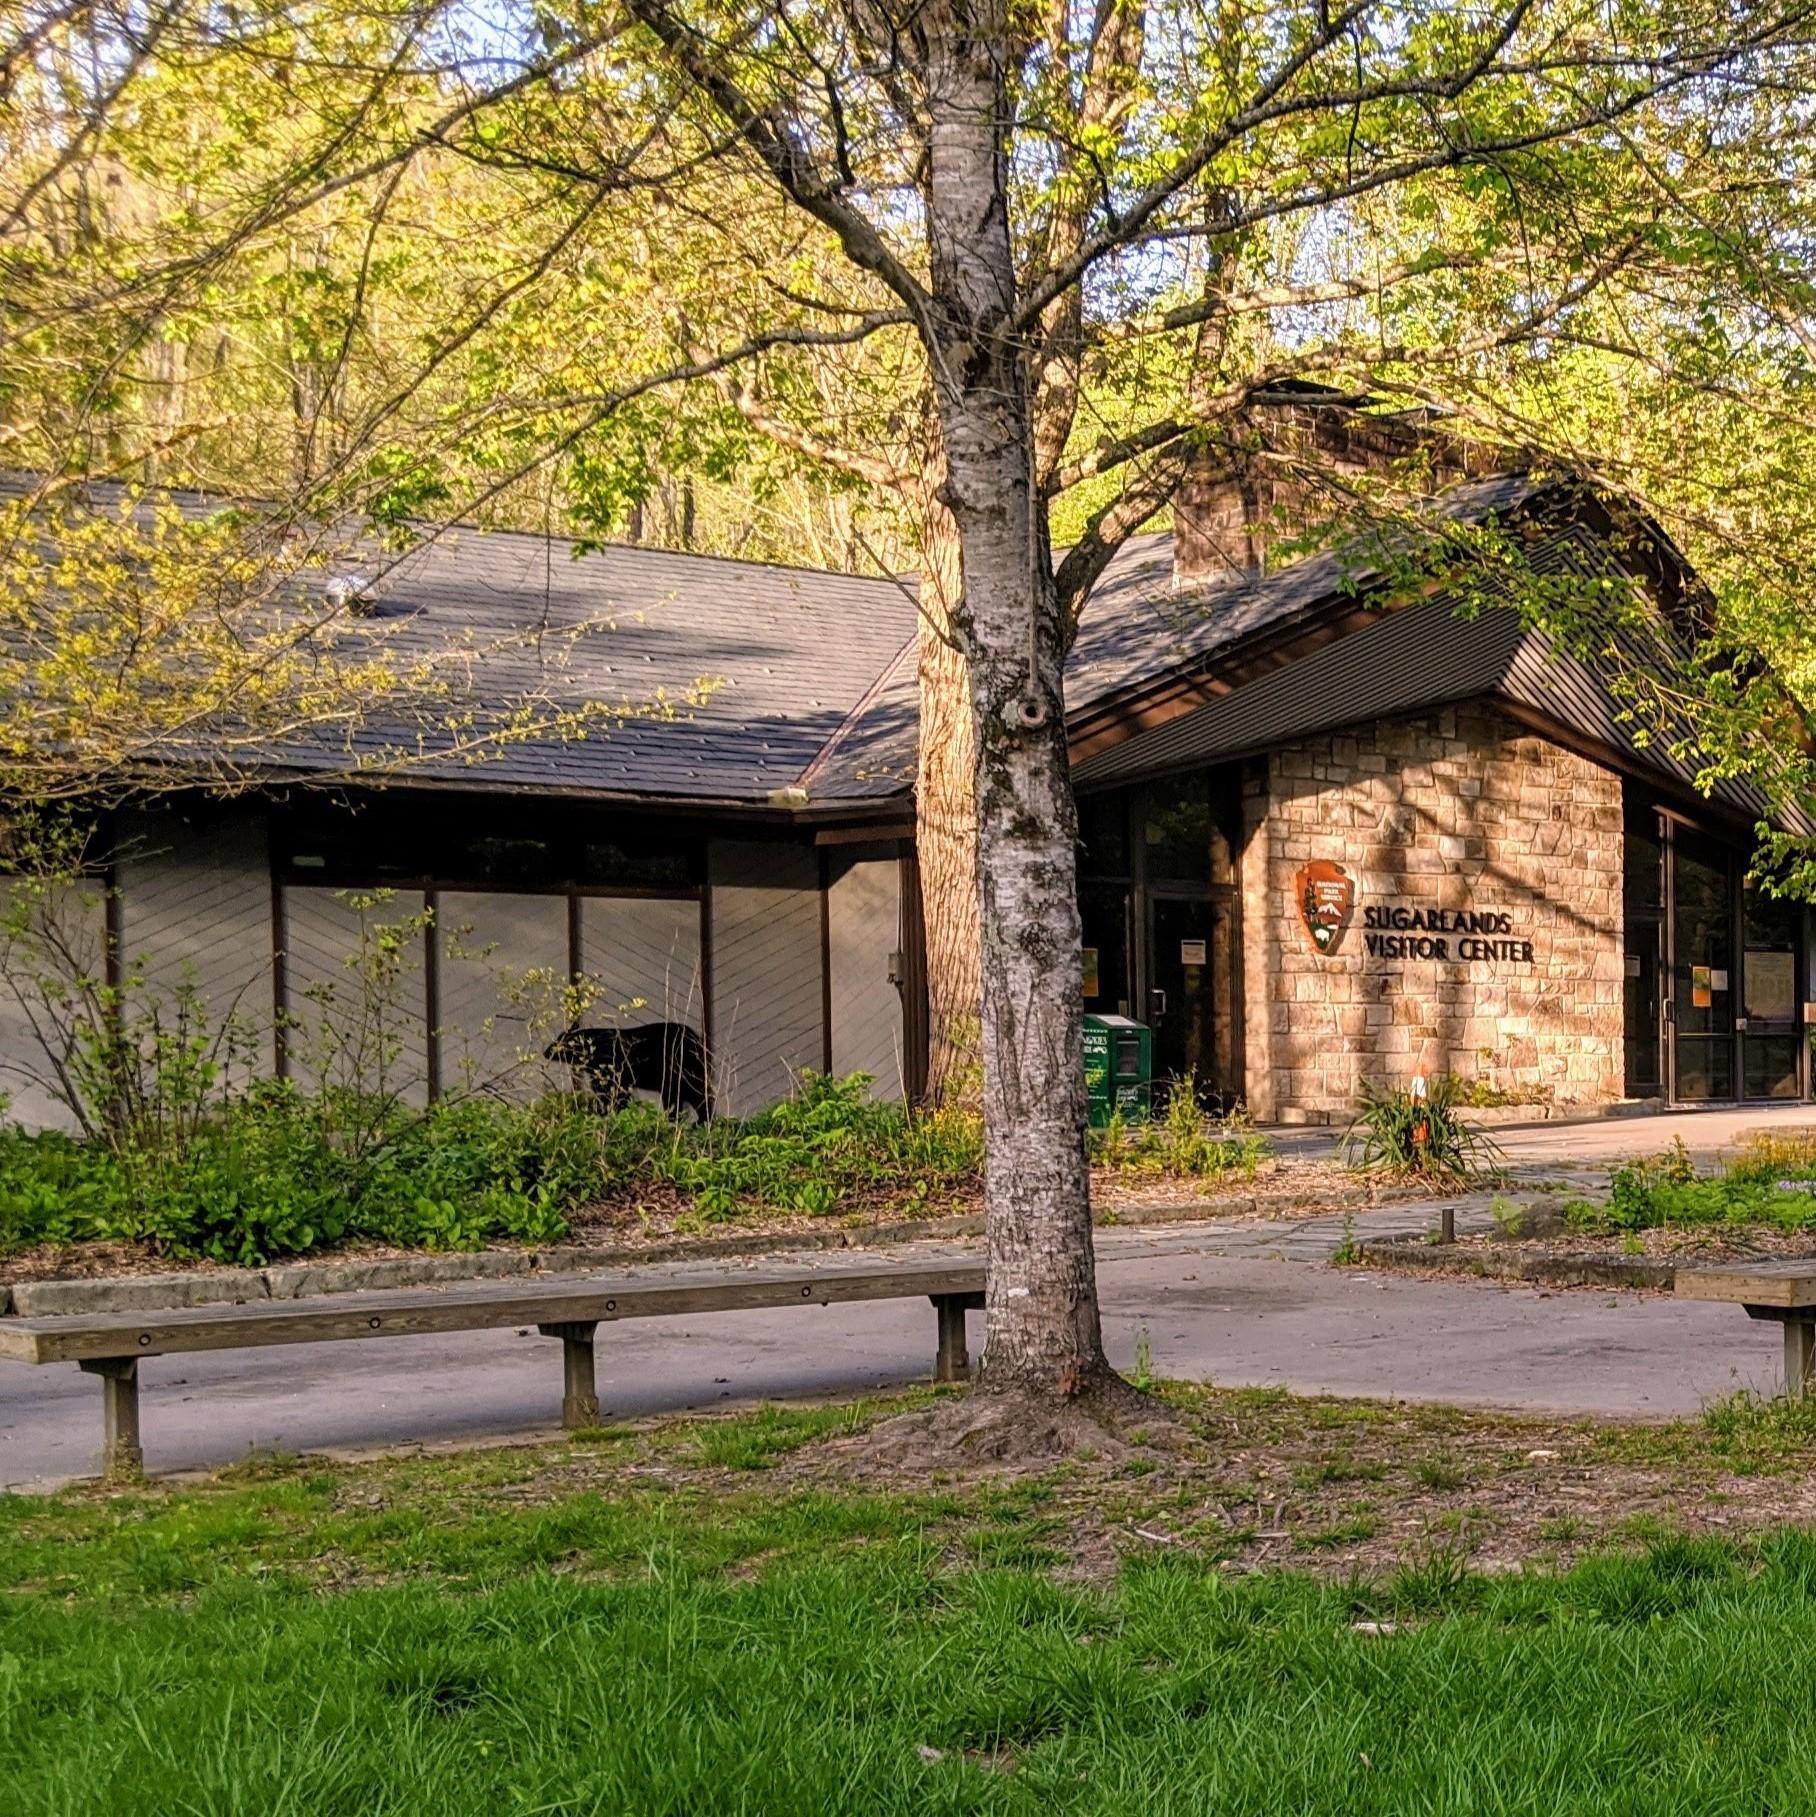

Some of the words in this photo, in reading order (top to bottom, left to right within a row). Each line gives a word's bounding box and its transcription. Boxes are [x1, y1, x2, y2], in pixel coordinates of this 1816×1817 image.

[1364, 907, 1512, 934] SUGARLANDS
[1365, 935, 1448, 960] VISITOR
[1458, 938, 1535, 963] CENTER
